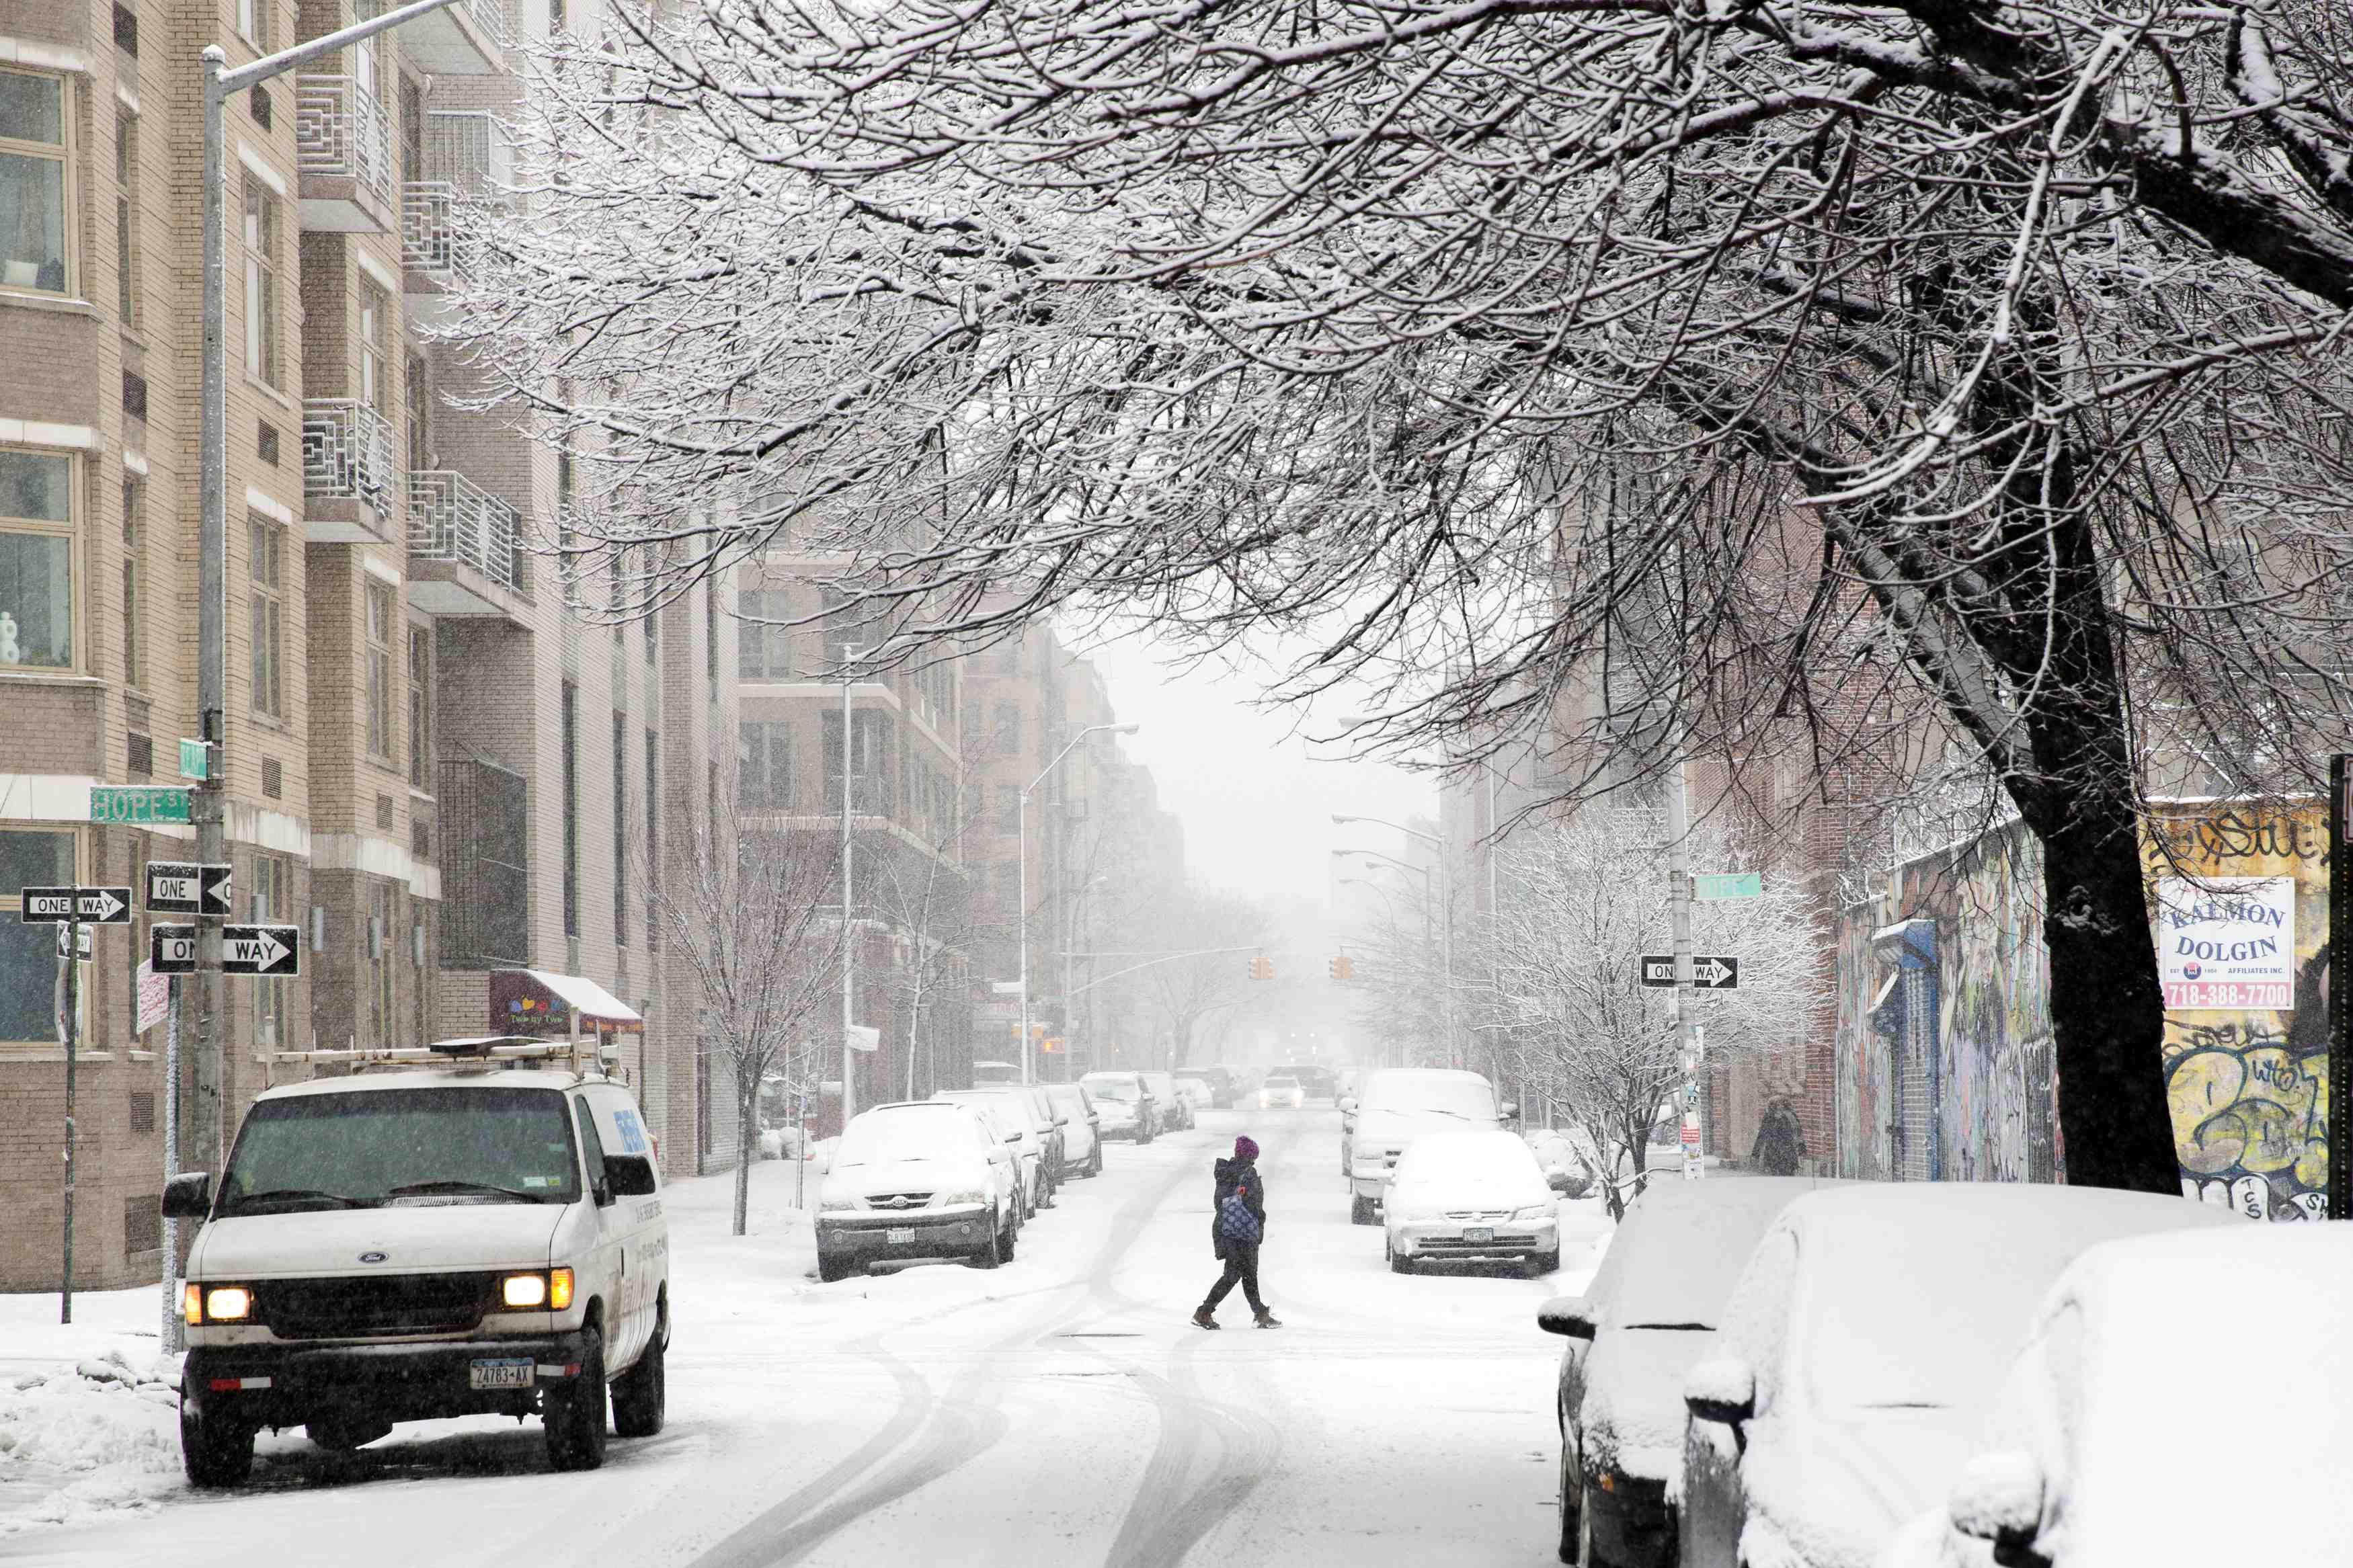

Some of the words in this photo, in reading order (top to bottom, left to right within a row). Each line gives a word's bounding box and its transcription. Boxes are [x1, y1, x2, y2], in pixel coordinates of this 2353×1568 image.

[93, 792, 163, 821] HOPE
[160, 880, 186, 898] ONE
[38, 899, 69, 912] ONE
[83, 899, 114, 912] WAY
[2169, 902, 2286, 930] KALMON
[235, 942, 276, 960] WAY
[2175, 935, 2278, 962] DOLGIN
[1655, 965, 1673, 978] ON
[1695, 966, 1723, 979] WAY
[2169, 985, 2286, 1005] 718-388-7700
